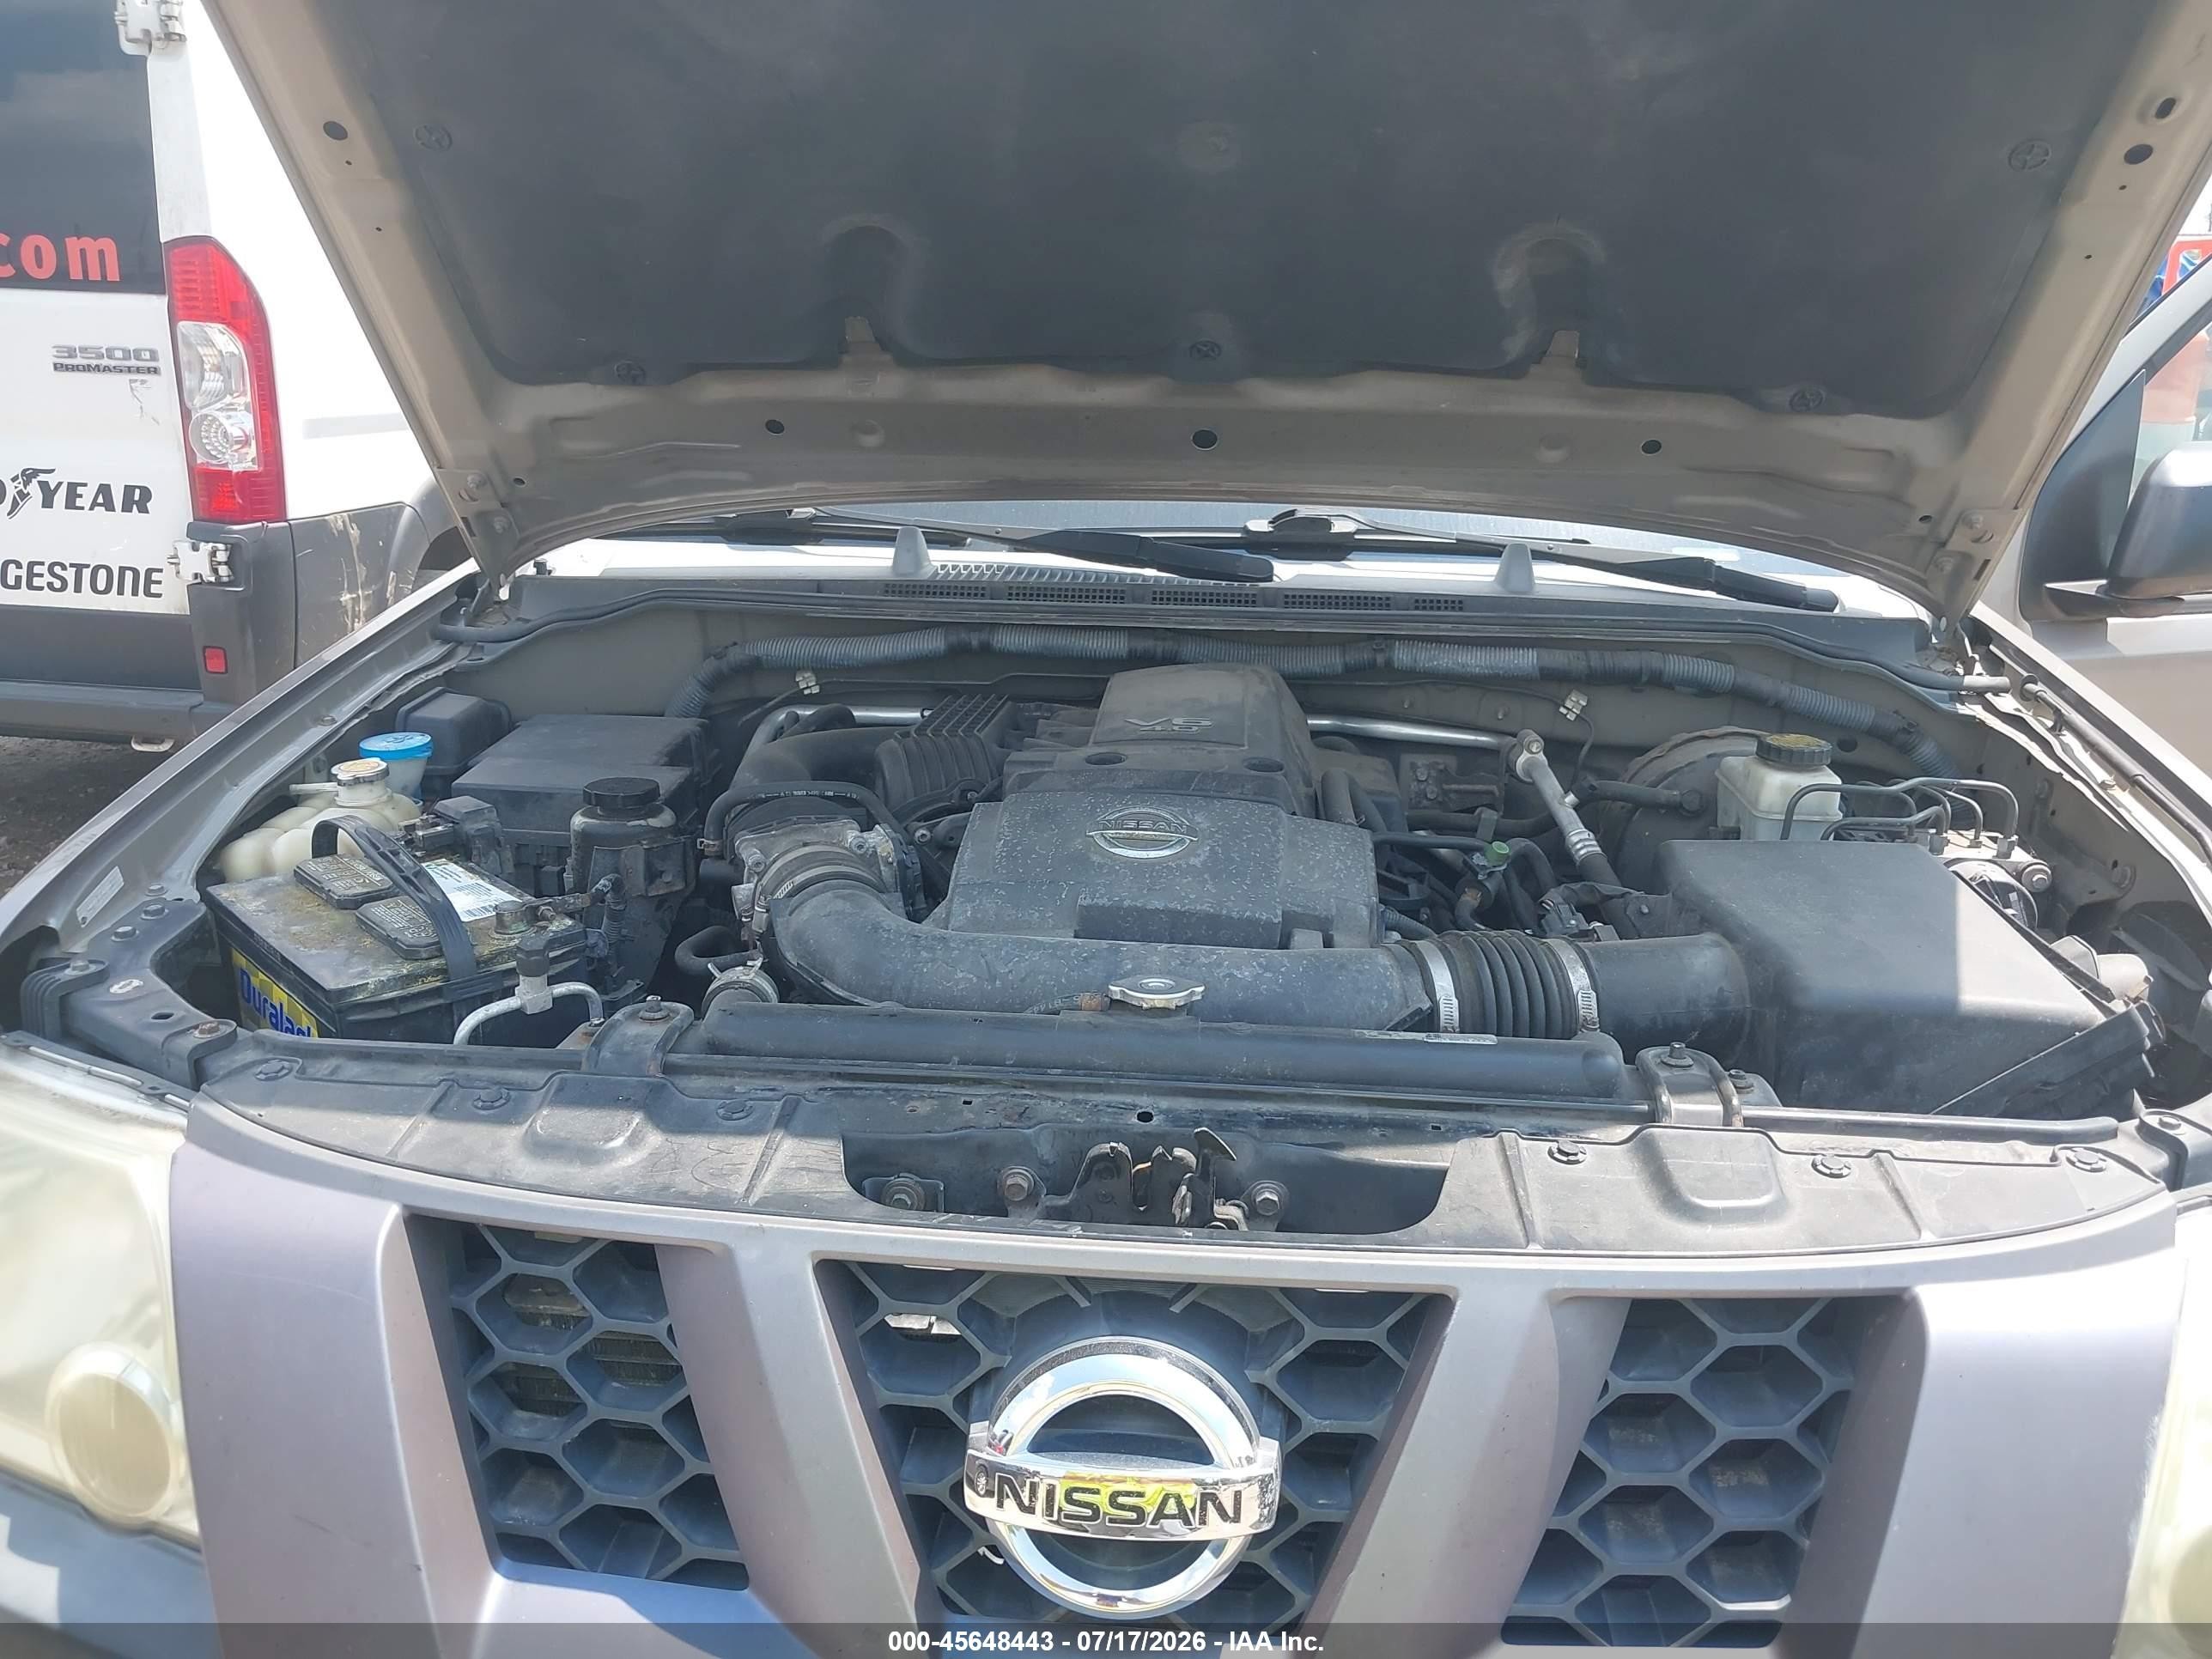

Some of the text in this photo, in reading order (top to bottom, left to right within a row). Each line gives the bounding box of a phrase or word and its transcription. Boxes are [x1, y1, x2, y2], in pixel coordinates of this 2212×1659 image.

[52, 344, 159, 362] 3500
[1123, 717, 1213, 727] V6
[1098, 819, 1188, 835] NISSAN
[995, 1472, 1243, 1528] NISSAN
